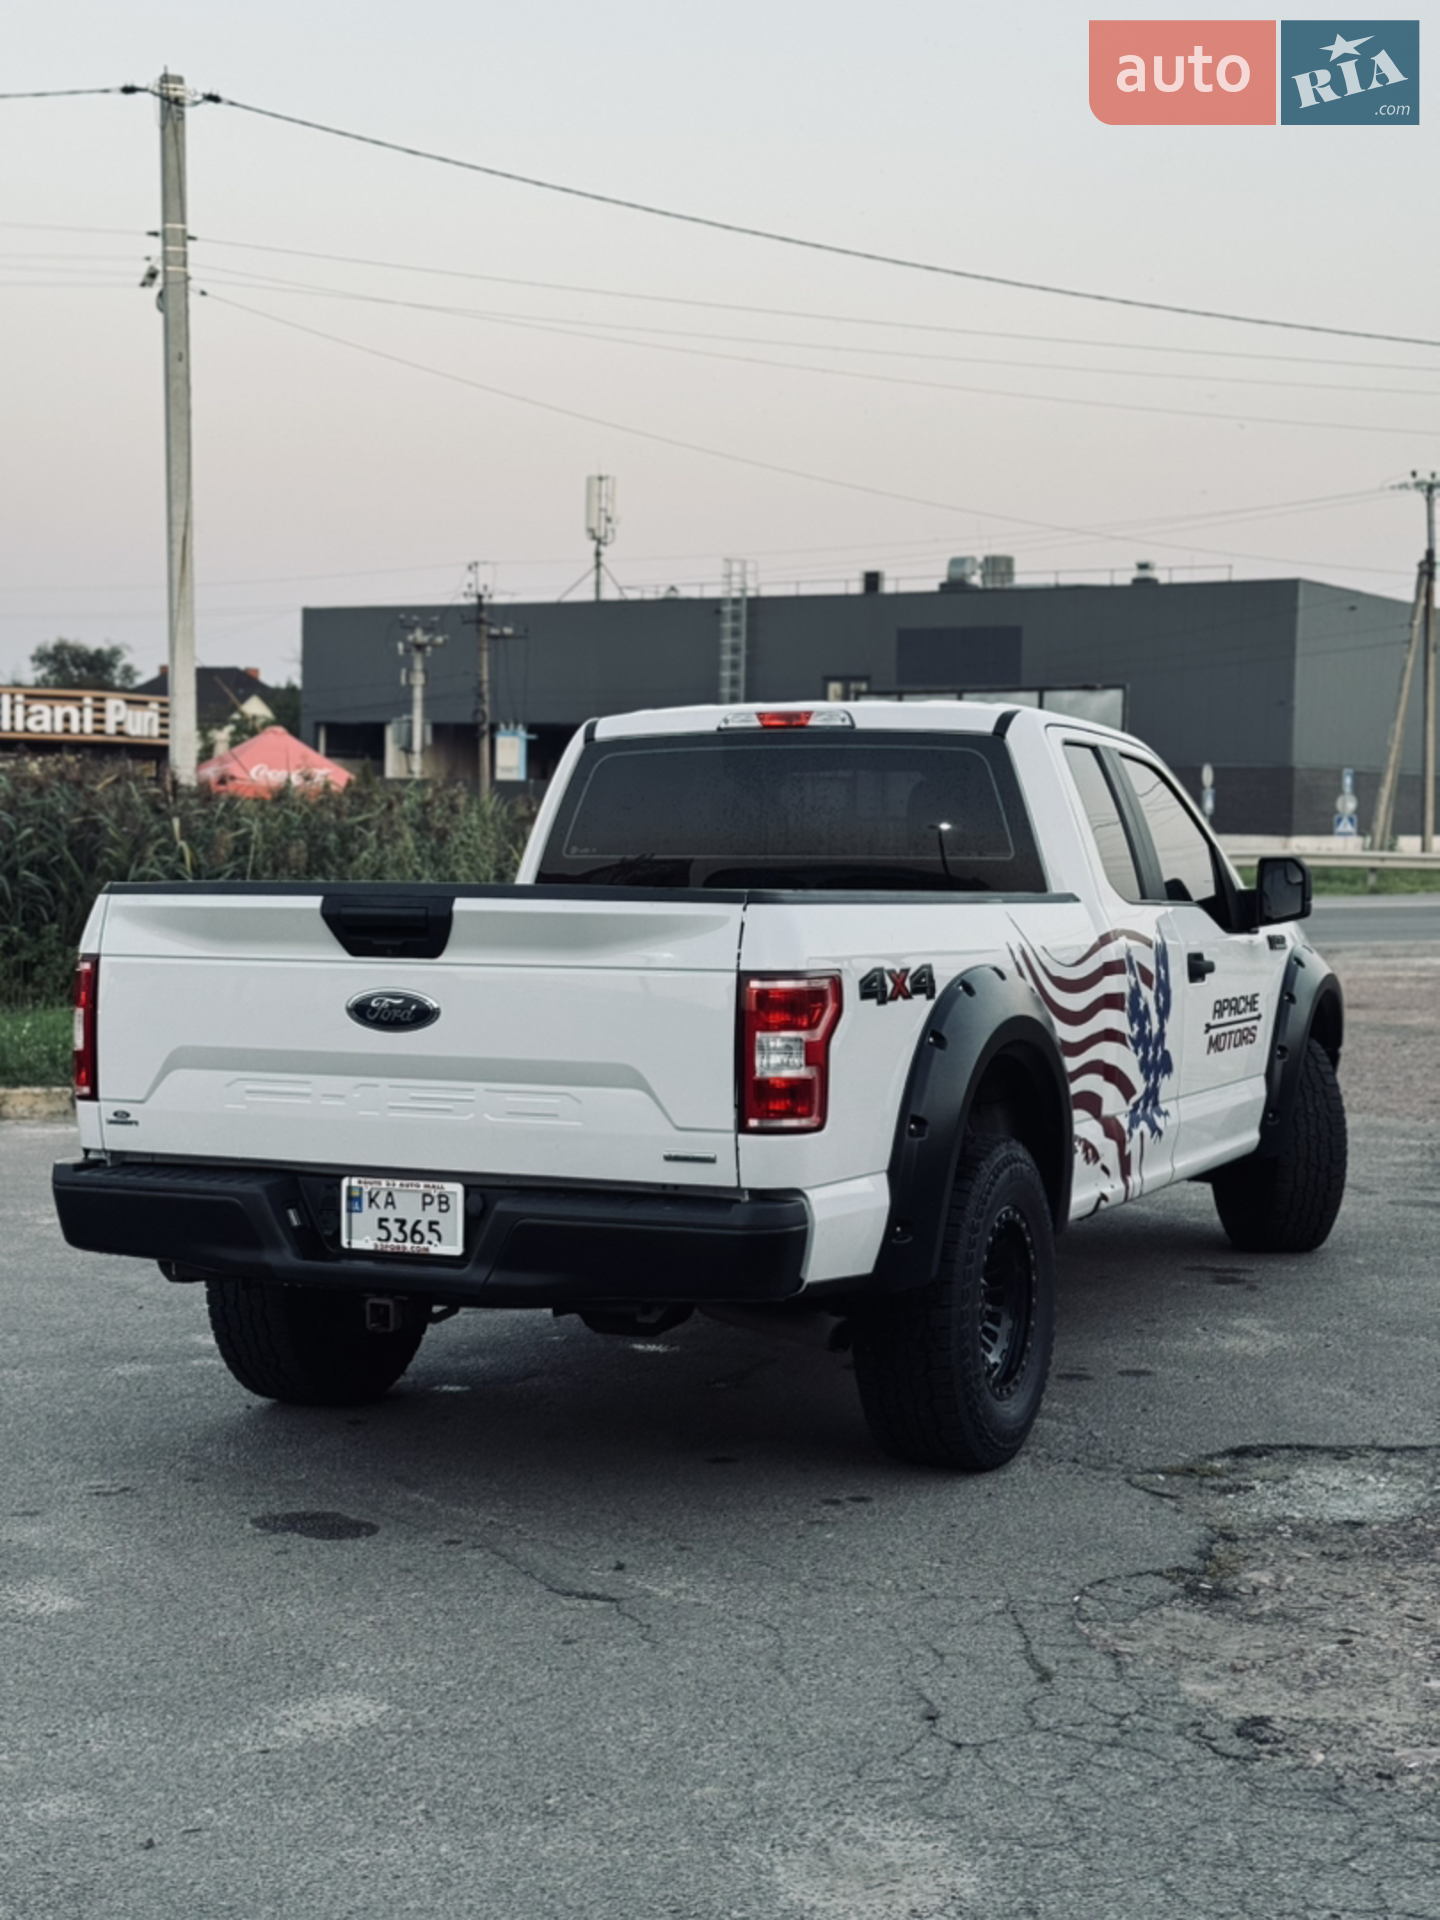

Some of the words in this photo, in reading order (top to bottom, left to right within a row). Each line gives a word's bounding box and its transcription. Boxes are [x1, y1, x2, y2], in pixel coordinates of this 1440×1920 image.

[366, 996, 417, 1022] Ford
[1212, 992, 1260, 1020] APACHE
[1206, 1025, 1258, 1055] MOTORS
[367, 1190, 397, 1211] KA
[421, 1192, 451, 1214] PB
[377, 1217, 442, 1245] 5365
